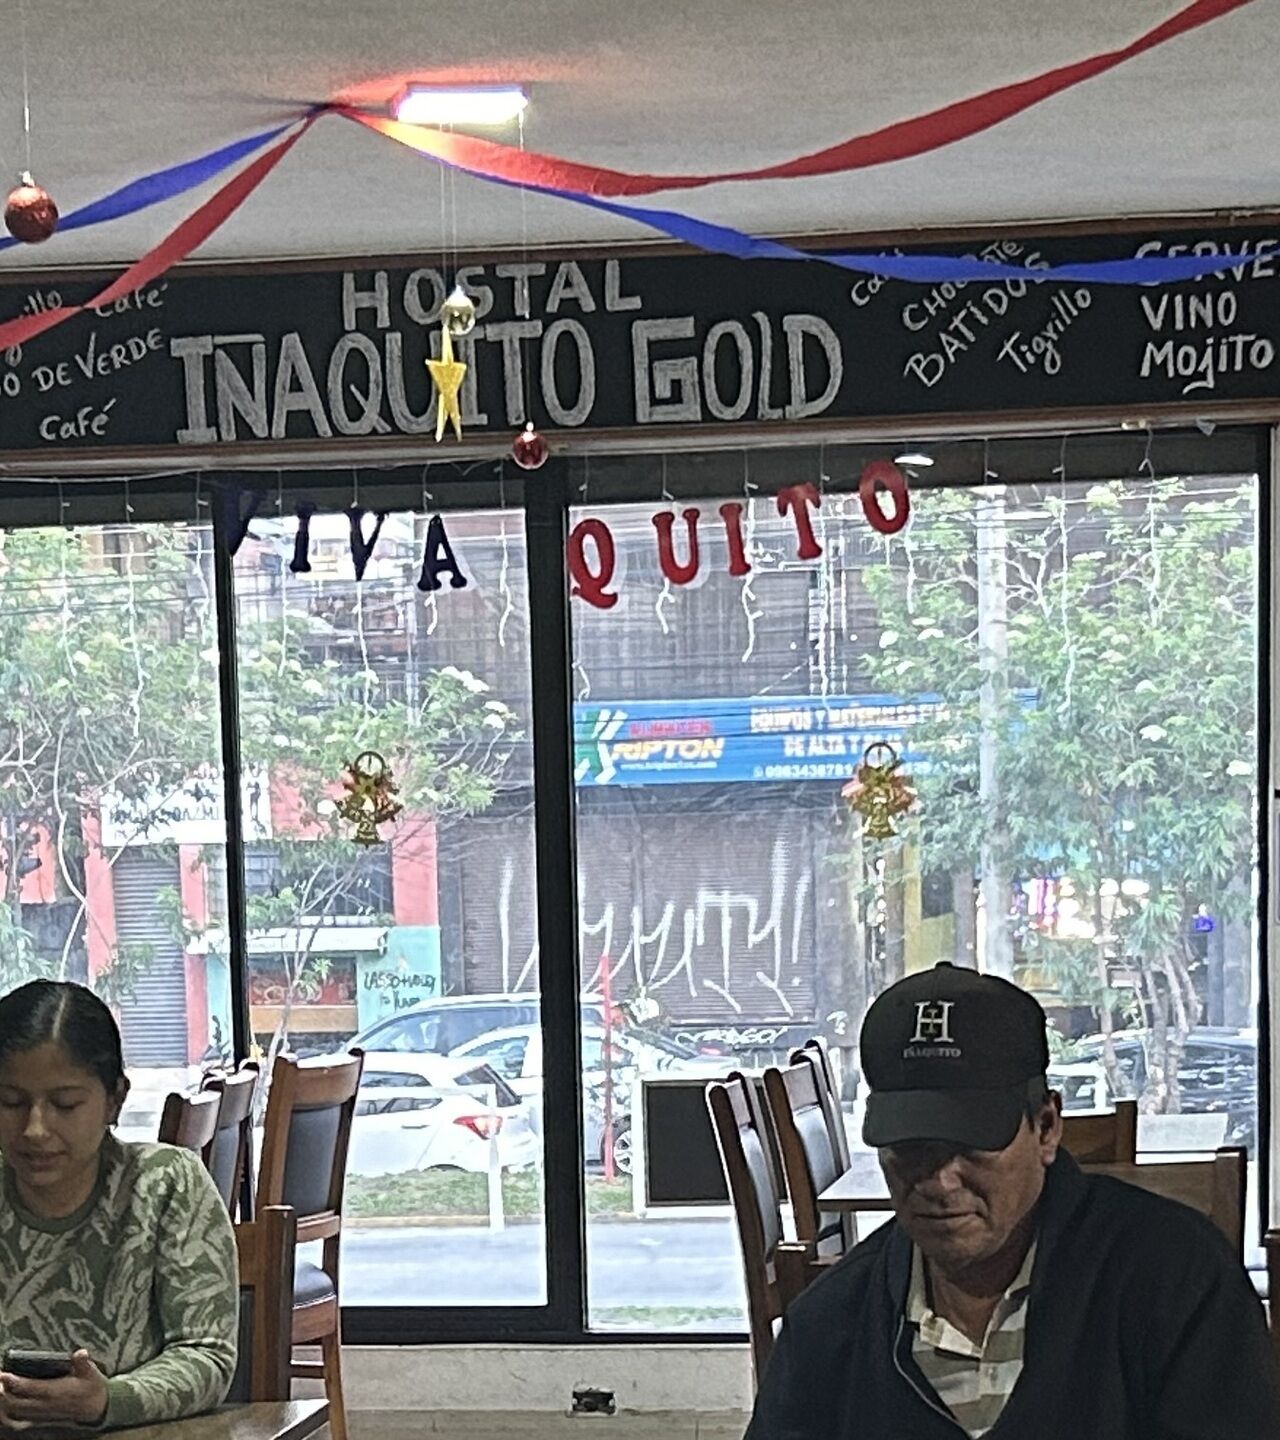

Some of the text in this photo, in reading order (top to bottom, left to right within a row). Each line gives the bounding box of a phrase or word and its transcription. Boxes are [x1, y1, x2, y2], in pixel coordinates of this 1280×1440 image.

[342, 258, 642, 331] HOSTAL
[1140, 291, 1238, 332] VINO
[31, 362, 73, 392] DE
[632, 311, 844, 423] GOLD
[566, 460, 910, 609] QUITO
